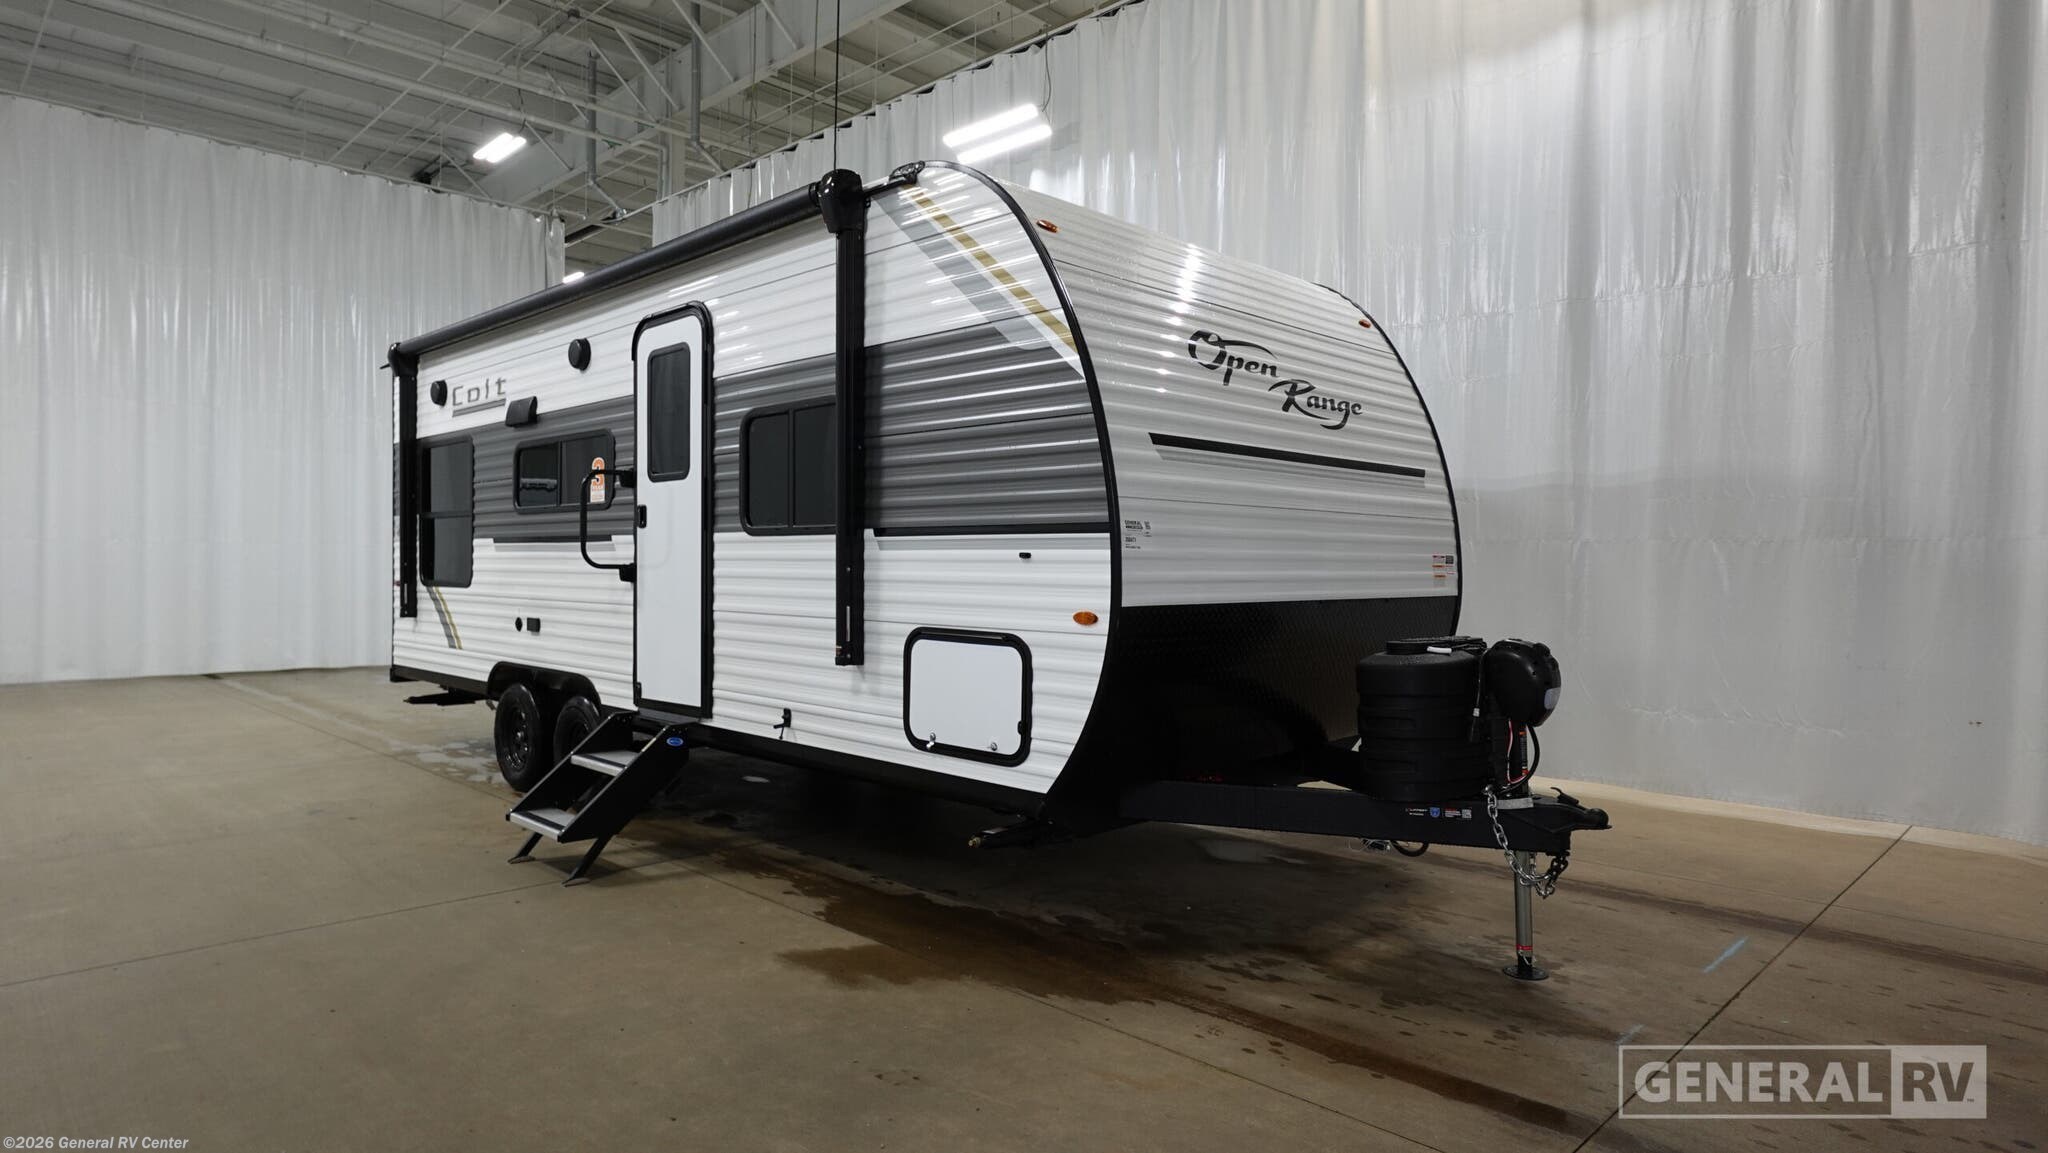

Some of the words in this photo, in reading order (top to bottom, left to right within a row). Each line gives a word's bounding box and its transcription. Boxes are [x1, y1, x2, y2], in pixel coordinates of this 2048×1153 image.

[1188, 330, 1280, 386] Open
[452, 377, 506, 406] Colt
[1268, 379, 1363, 430] Range
